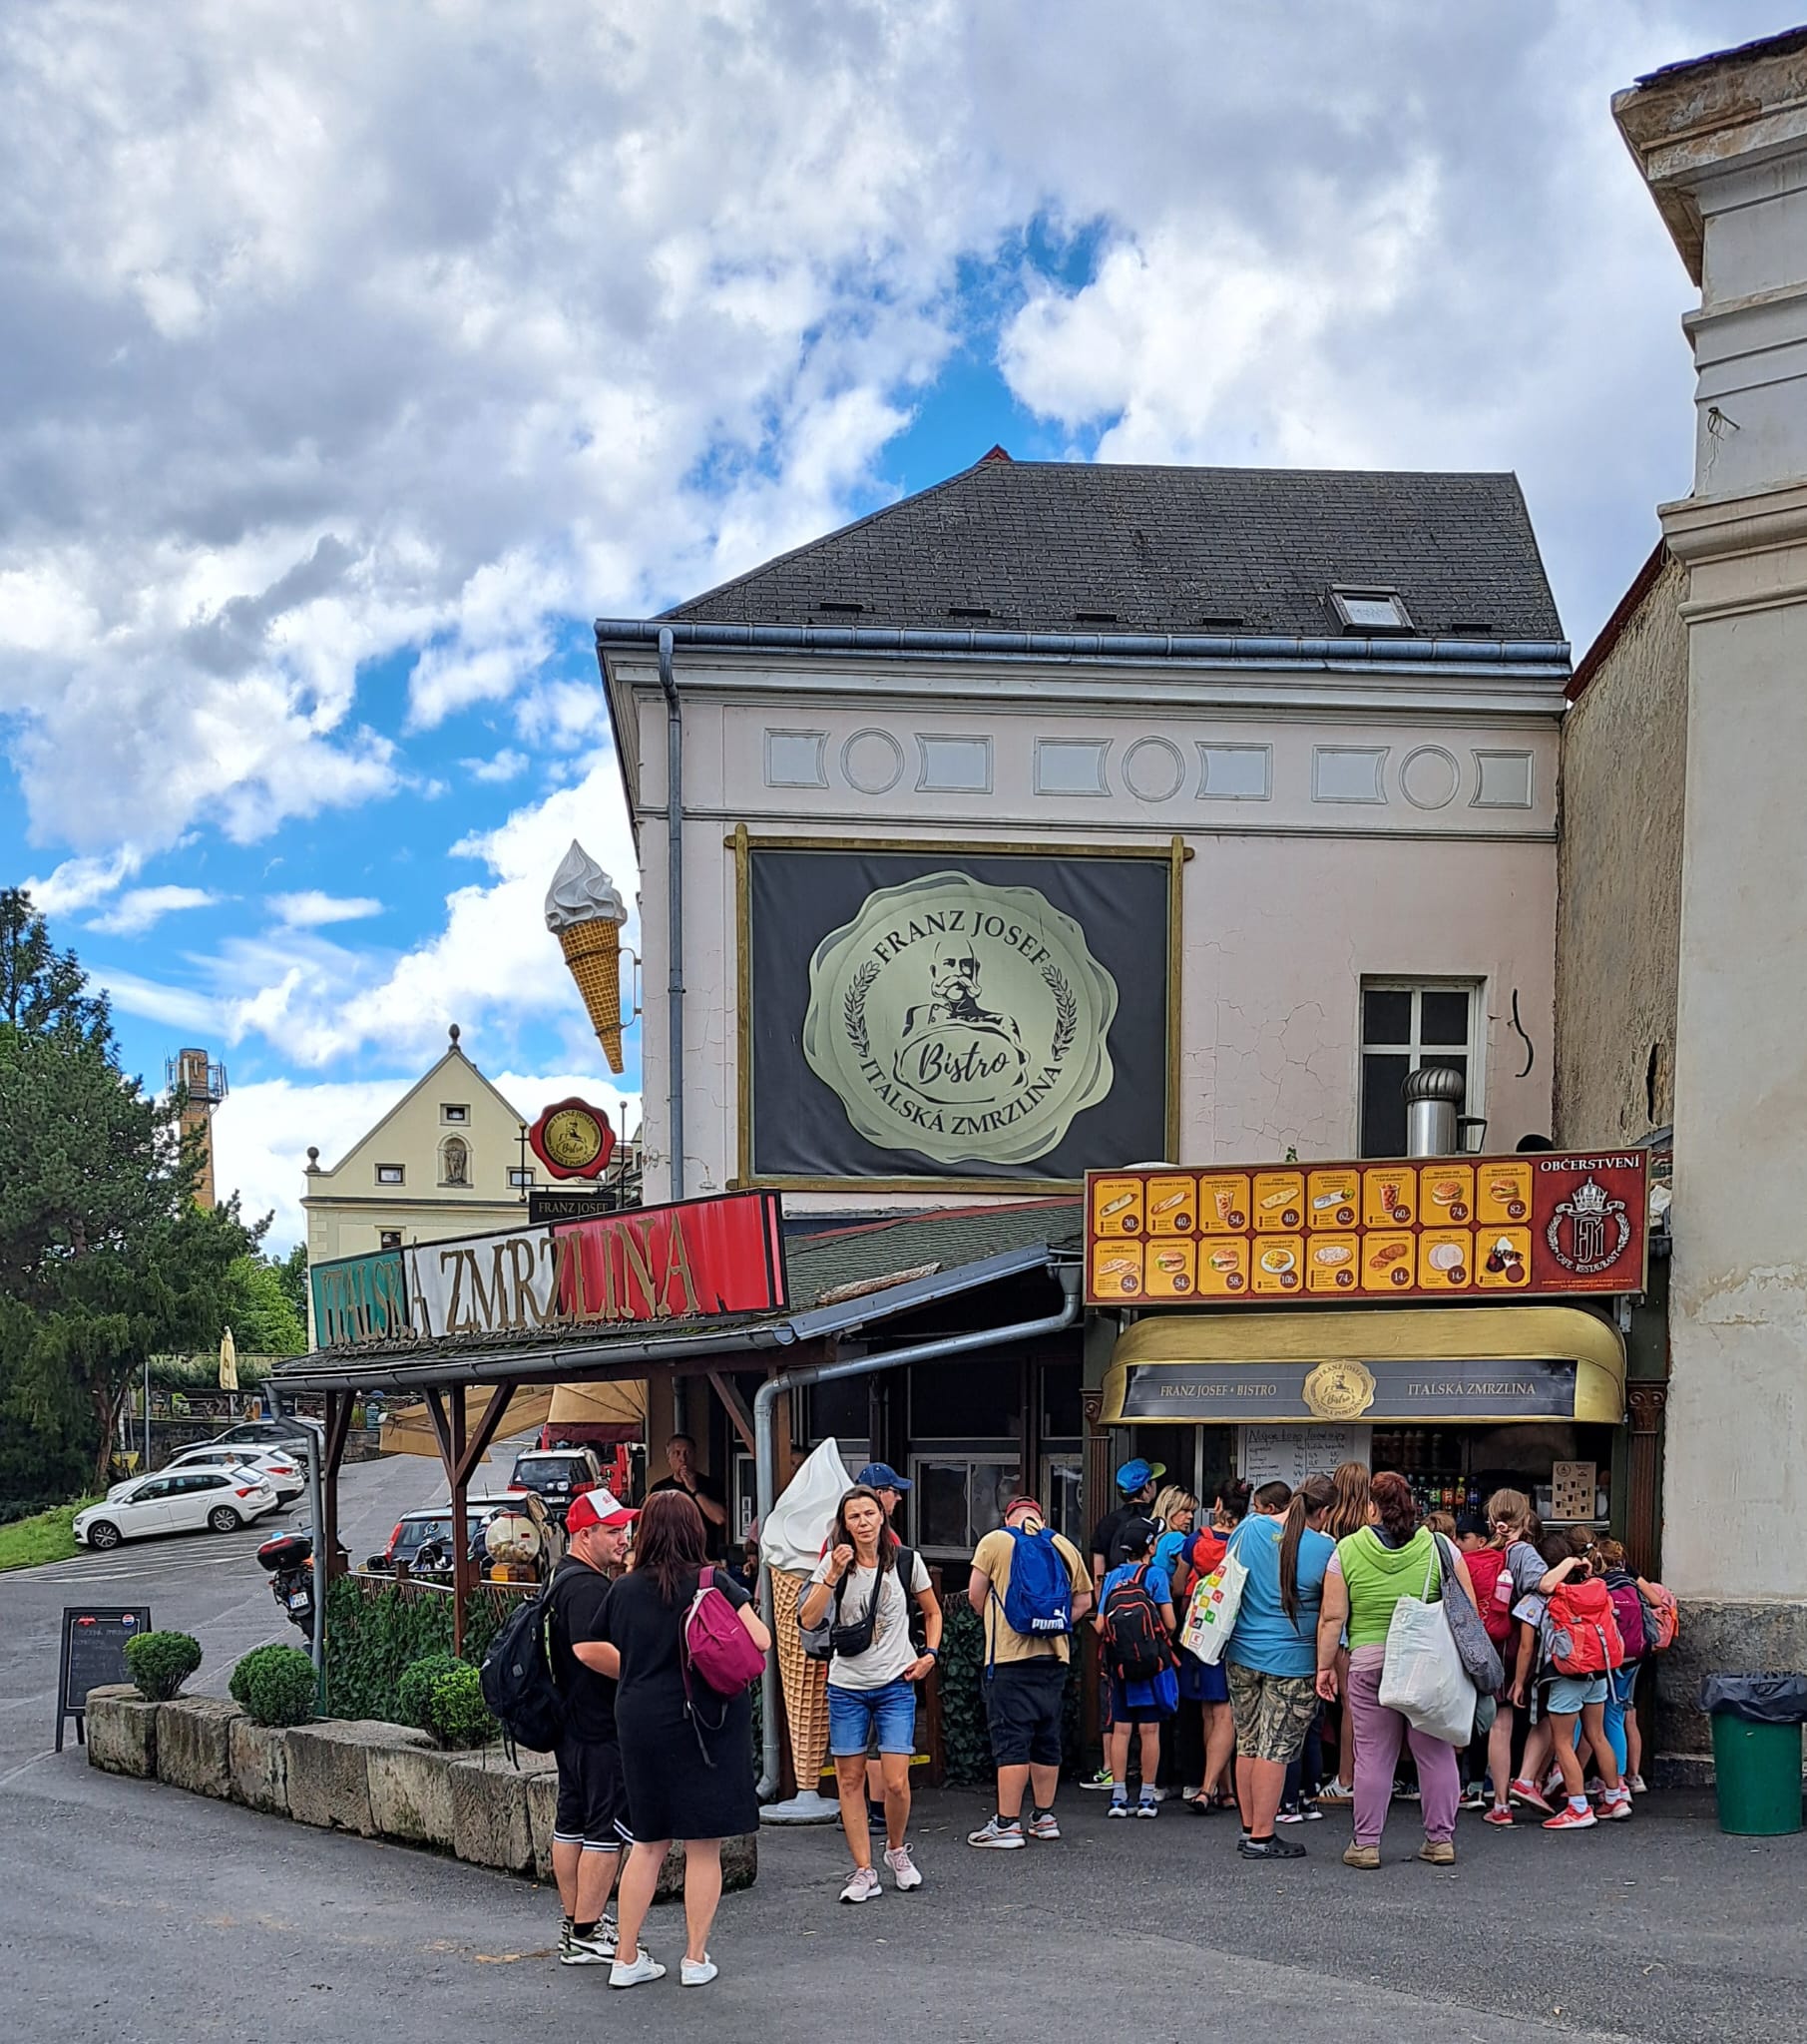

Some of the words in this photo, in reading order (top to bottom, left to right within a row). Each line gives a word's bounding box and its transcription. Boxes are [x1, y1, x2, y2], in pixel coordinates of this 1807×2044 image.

[872, 910, 966, 964] FRANZ
[970, 911, 1051, 966] JOSEF
[919, 1041, 1010, 1085] Bistro
[859, 1058, 945, 1134] ITALSKÁ
[950, 1065, 1063, 1136] ZMRZLINA
[1541, 1154, 1640, 1172] OBČERSTVENÍ
[538, 1202, 576, 1214] FRANZ
[440, 1212, 700, 1333] ZMRZLINA
[1159, 1384, 1196, 1397] FRANZ
[1196, 1384, 1228, 1398] JOSEF
[1236, 1383, 1277, 1396] BISTRO
[1407, 1380, 1464, 1396] ITALSKÁ
[1465, 1381, 1536, 1395] ZMRZLINA
[1031, 1617, 1065, 1630] PUMA
